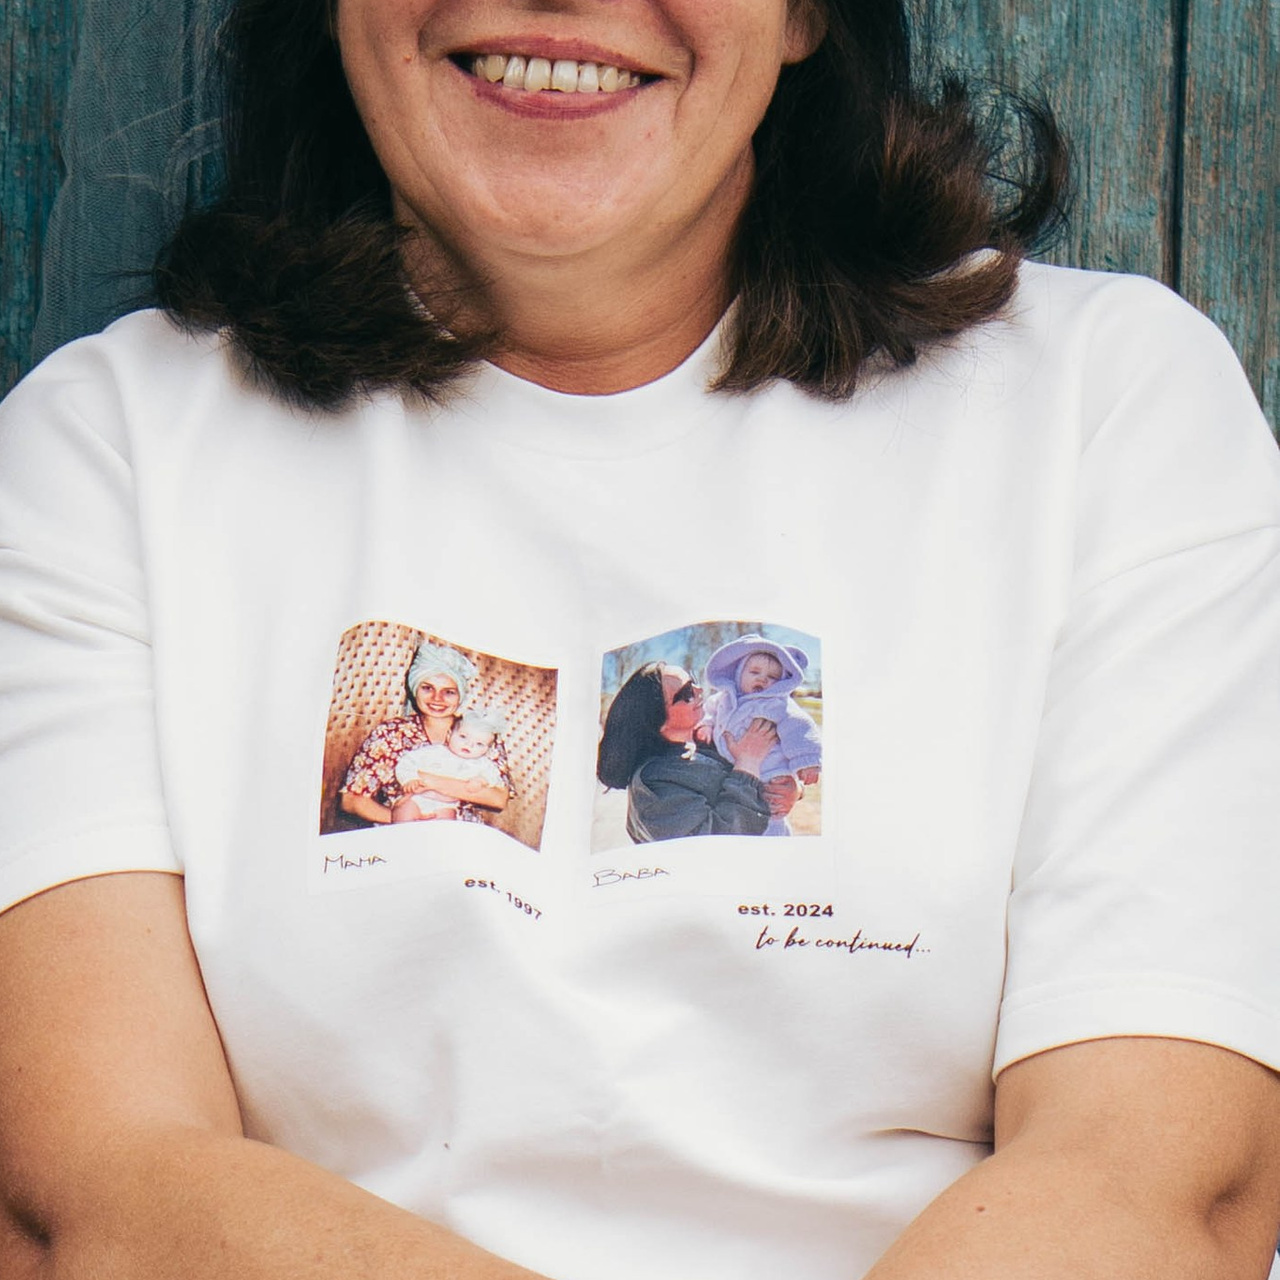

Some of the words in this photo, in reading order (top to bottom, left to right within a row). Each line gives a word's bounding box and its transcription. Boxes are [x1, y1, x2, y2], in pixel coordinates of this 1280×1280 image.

[464, 876, 500, 893] est.
[506, 891, 543, 920] 1997
[737, 903, 775, 917] est.
[783, 903, 834, 917] 2024
[755, 925, 778, 950] to
[783, 926, 810, 949] be
